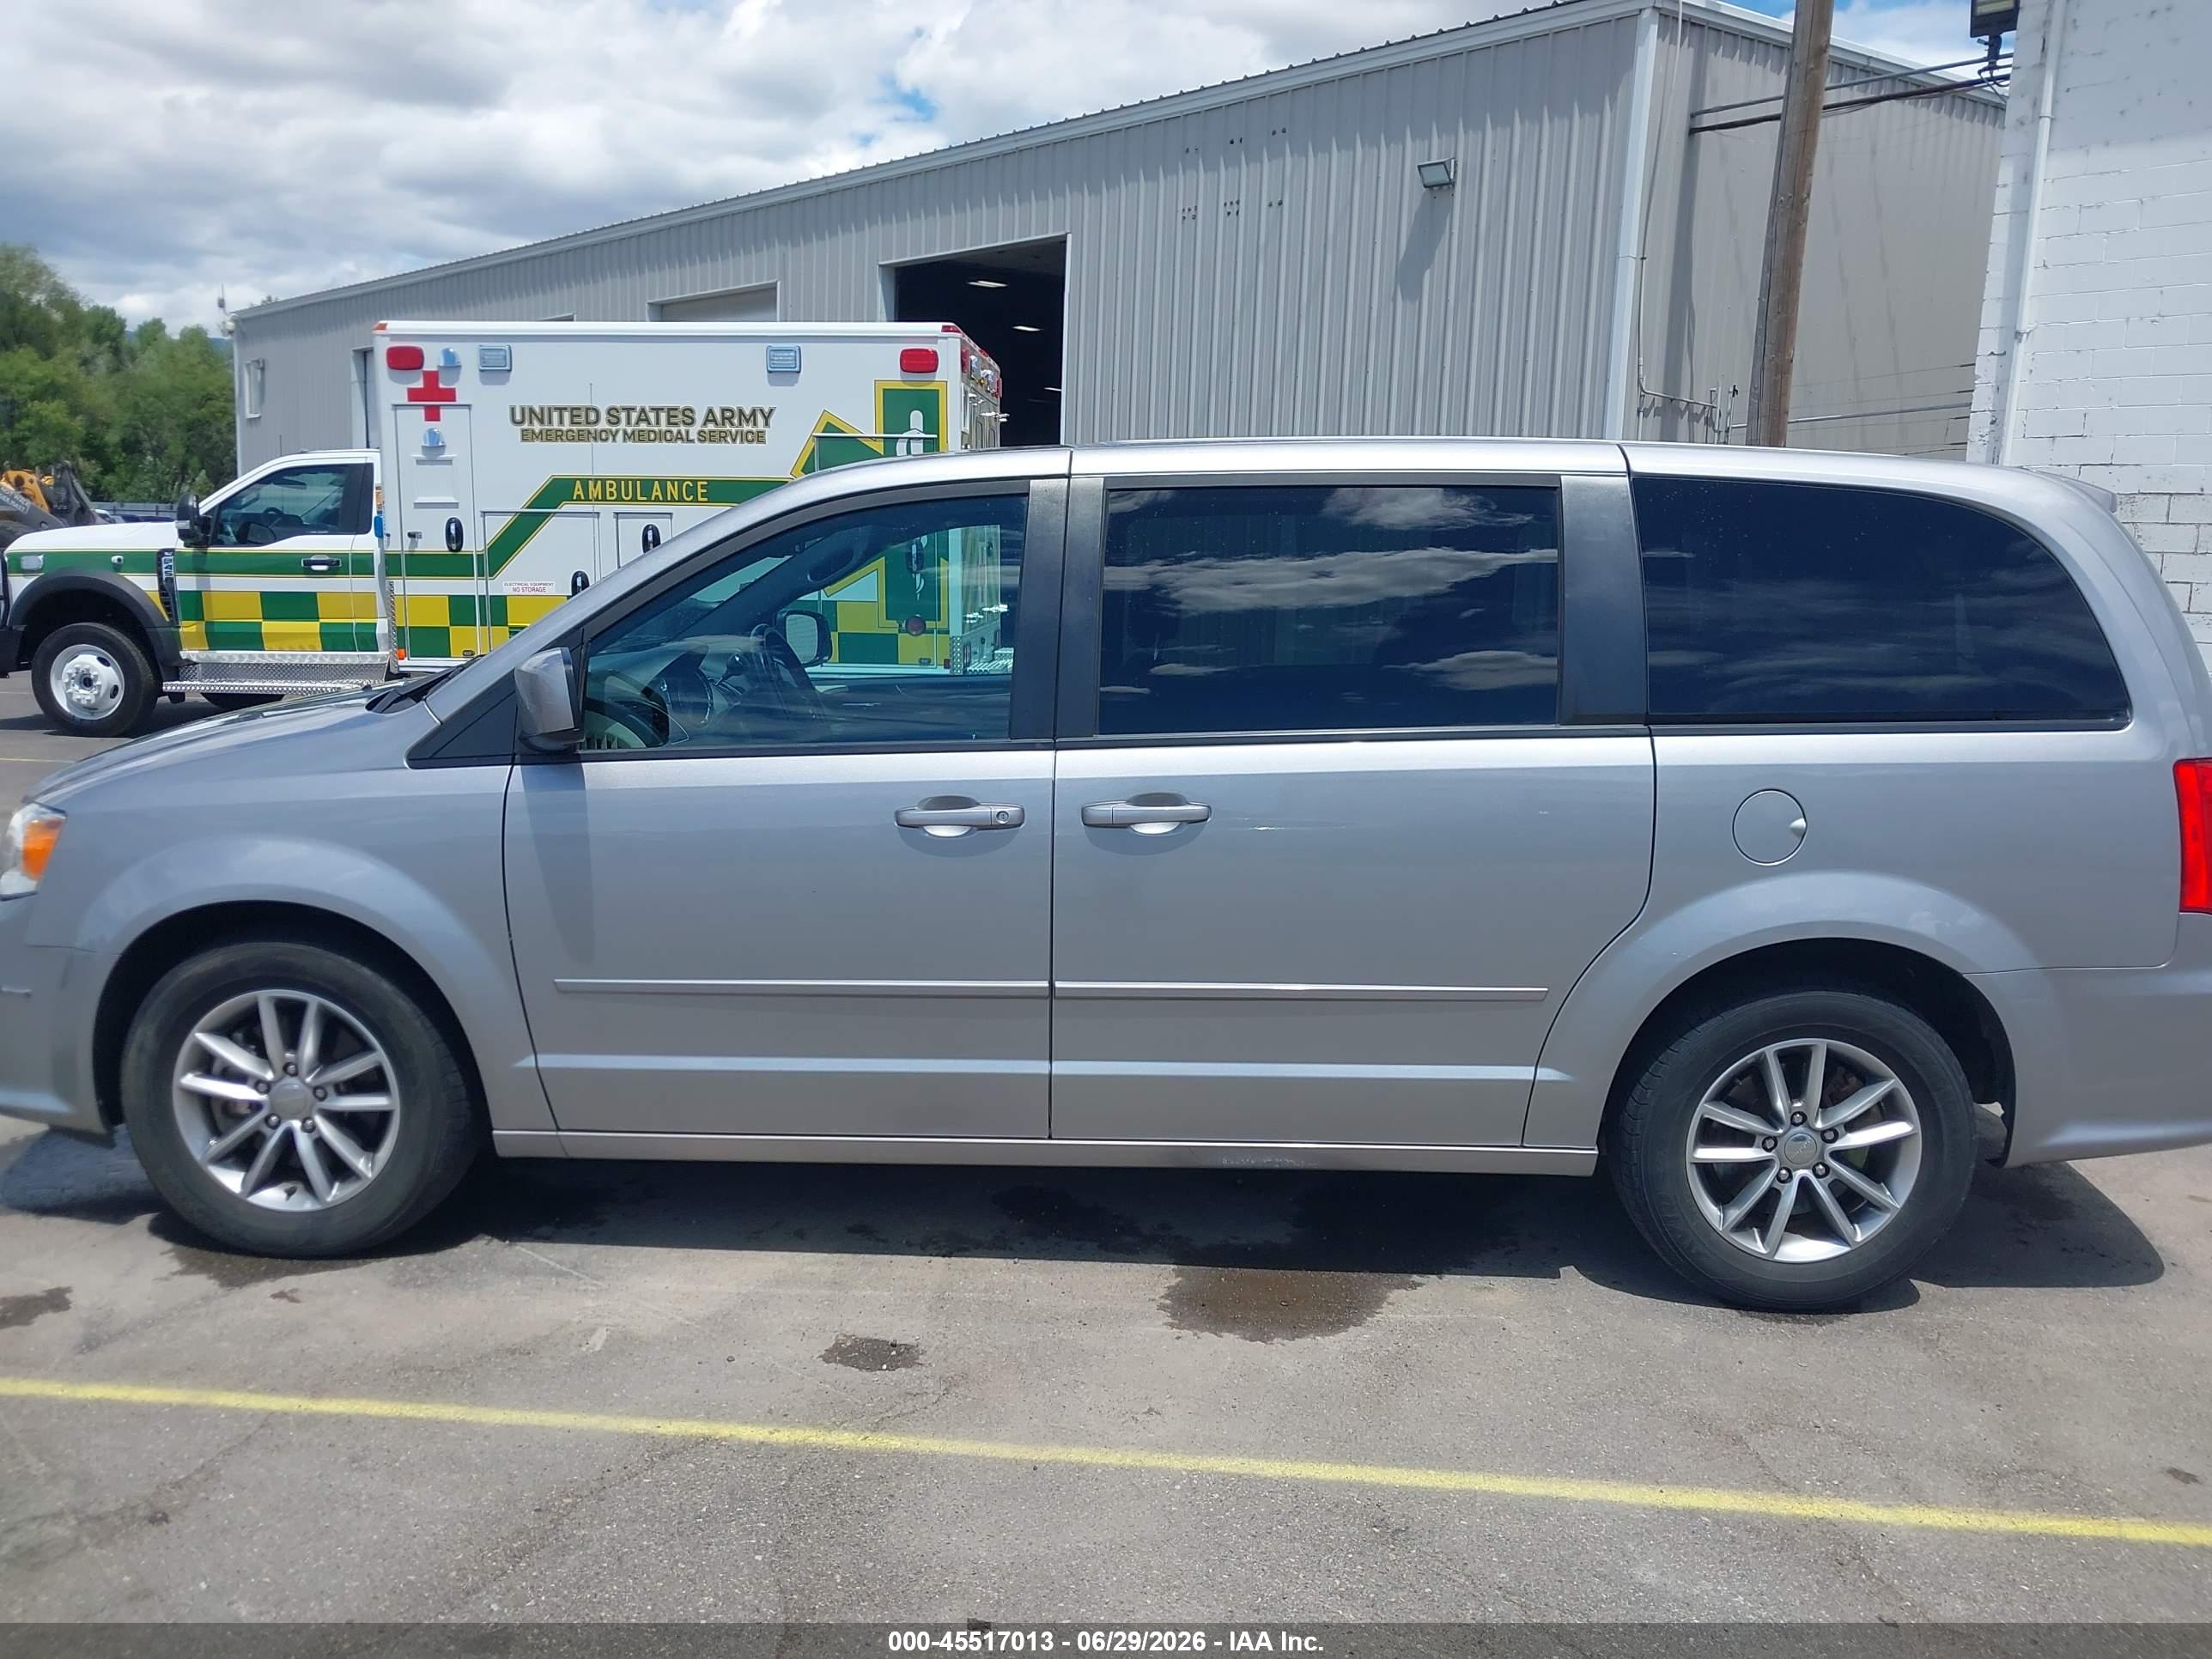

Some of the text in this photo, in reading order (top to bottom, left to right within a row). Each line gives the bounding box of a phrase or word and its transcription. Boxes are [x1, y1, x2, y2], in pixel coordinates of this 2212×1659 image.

[509, 405, 776, 428] UNITED STATES ARMY
[520, 428, 767, 444] EMERGENCY MEDICAL SERVICE
[572, 480, 708, 501] AMBULANCE
